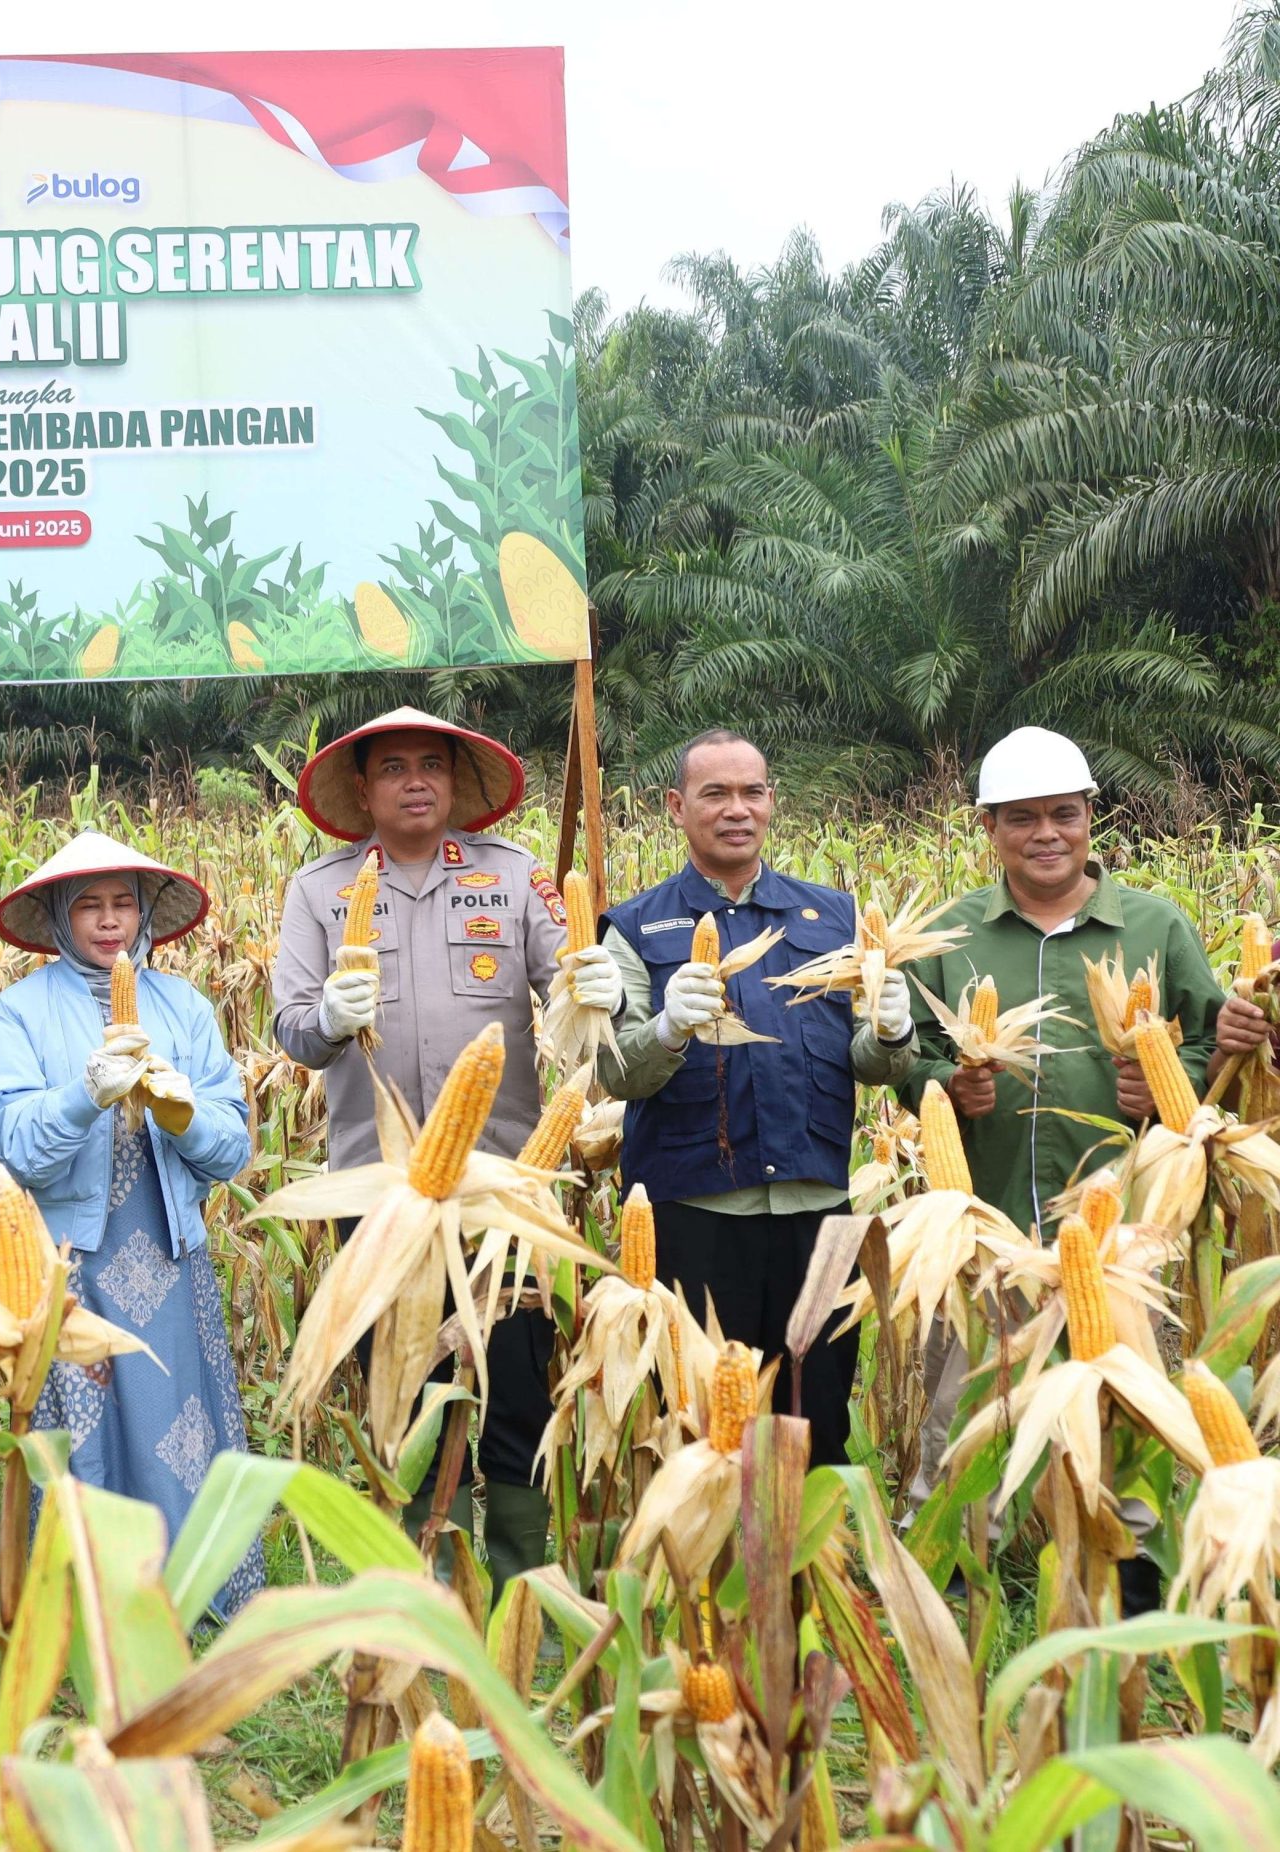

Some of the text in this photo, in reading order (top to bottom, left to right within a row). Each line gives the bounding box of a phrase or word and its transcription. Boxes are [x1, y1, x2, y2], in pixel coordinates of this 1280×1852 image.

[52, 173, 140, 203] bulog
[114, 228, 417, 295] SERENTAK
[78, 301, 121, 361] II
[160, 406, 315, 447] PANGAN
[34, 519, 83, 537] 2025
[451, 894, 509, 908] POLRI
